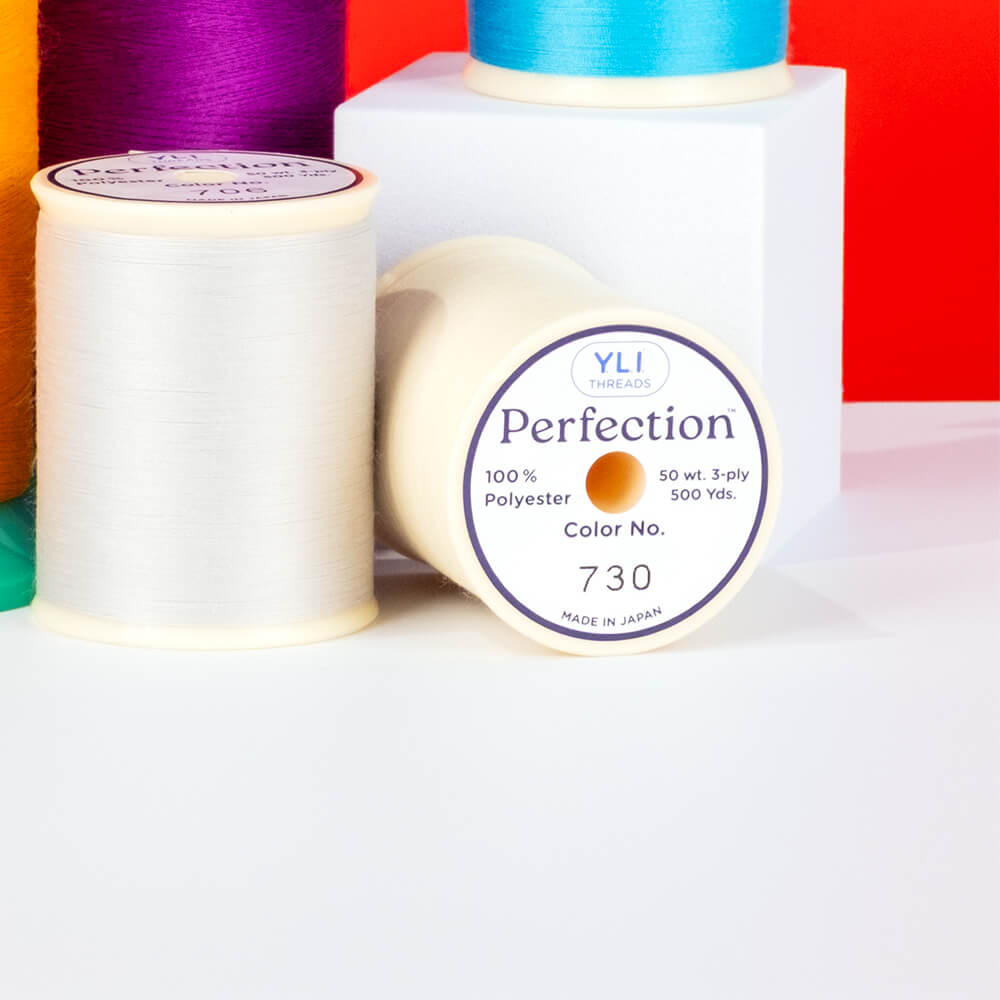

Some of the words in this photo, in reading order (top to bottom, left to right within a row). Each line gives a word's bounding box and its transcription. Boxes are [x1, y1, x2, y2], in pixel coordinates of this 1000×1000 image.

[190, 187, 268, 196] 706
[594, 351, 642, 374] YLI
[589, 378, 652, 389] THREADS
[659, 469, 679, 482] 50
[684, 469, 707, 481] wt.
[711, 467, 750, 483] 3-ply
[484, 491, 572, 509] Polyester
[670, 488, 702, 501] 500
[706, 487, 737, 500] Yds.
[563, 520, 623, 538] Color
[630, 519, 666, 537] No.
[579, 563, 652, 593] 730
[561, 610, 599, 627] MADE
[602, 617, 616, 627] IN
[620, 605, 663, 626] JAPAN
